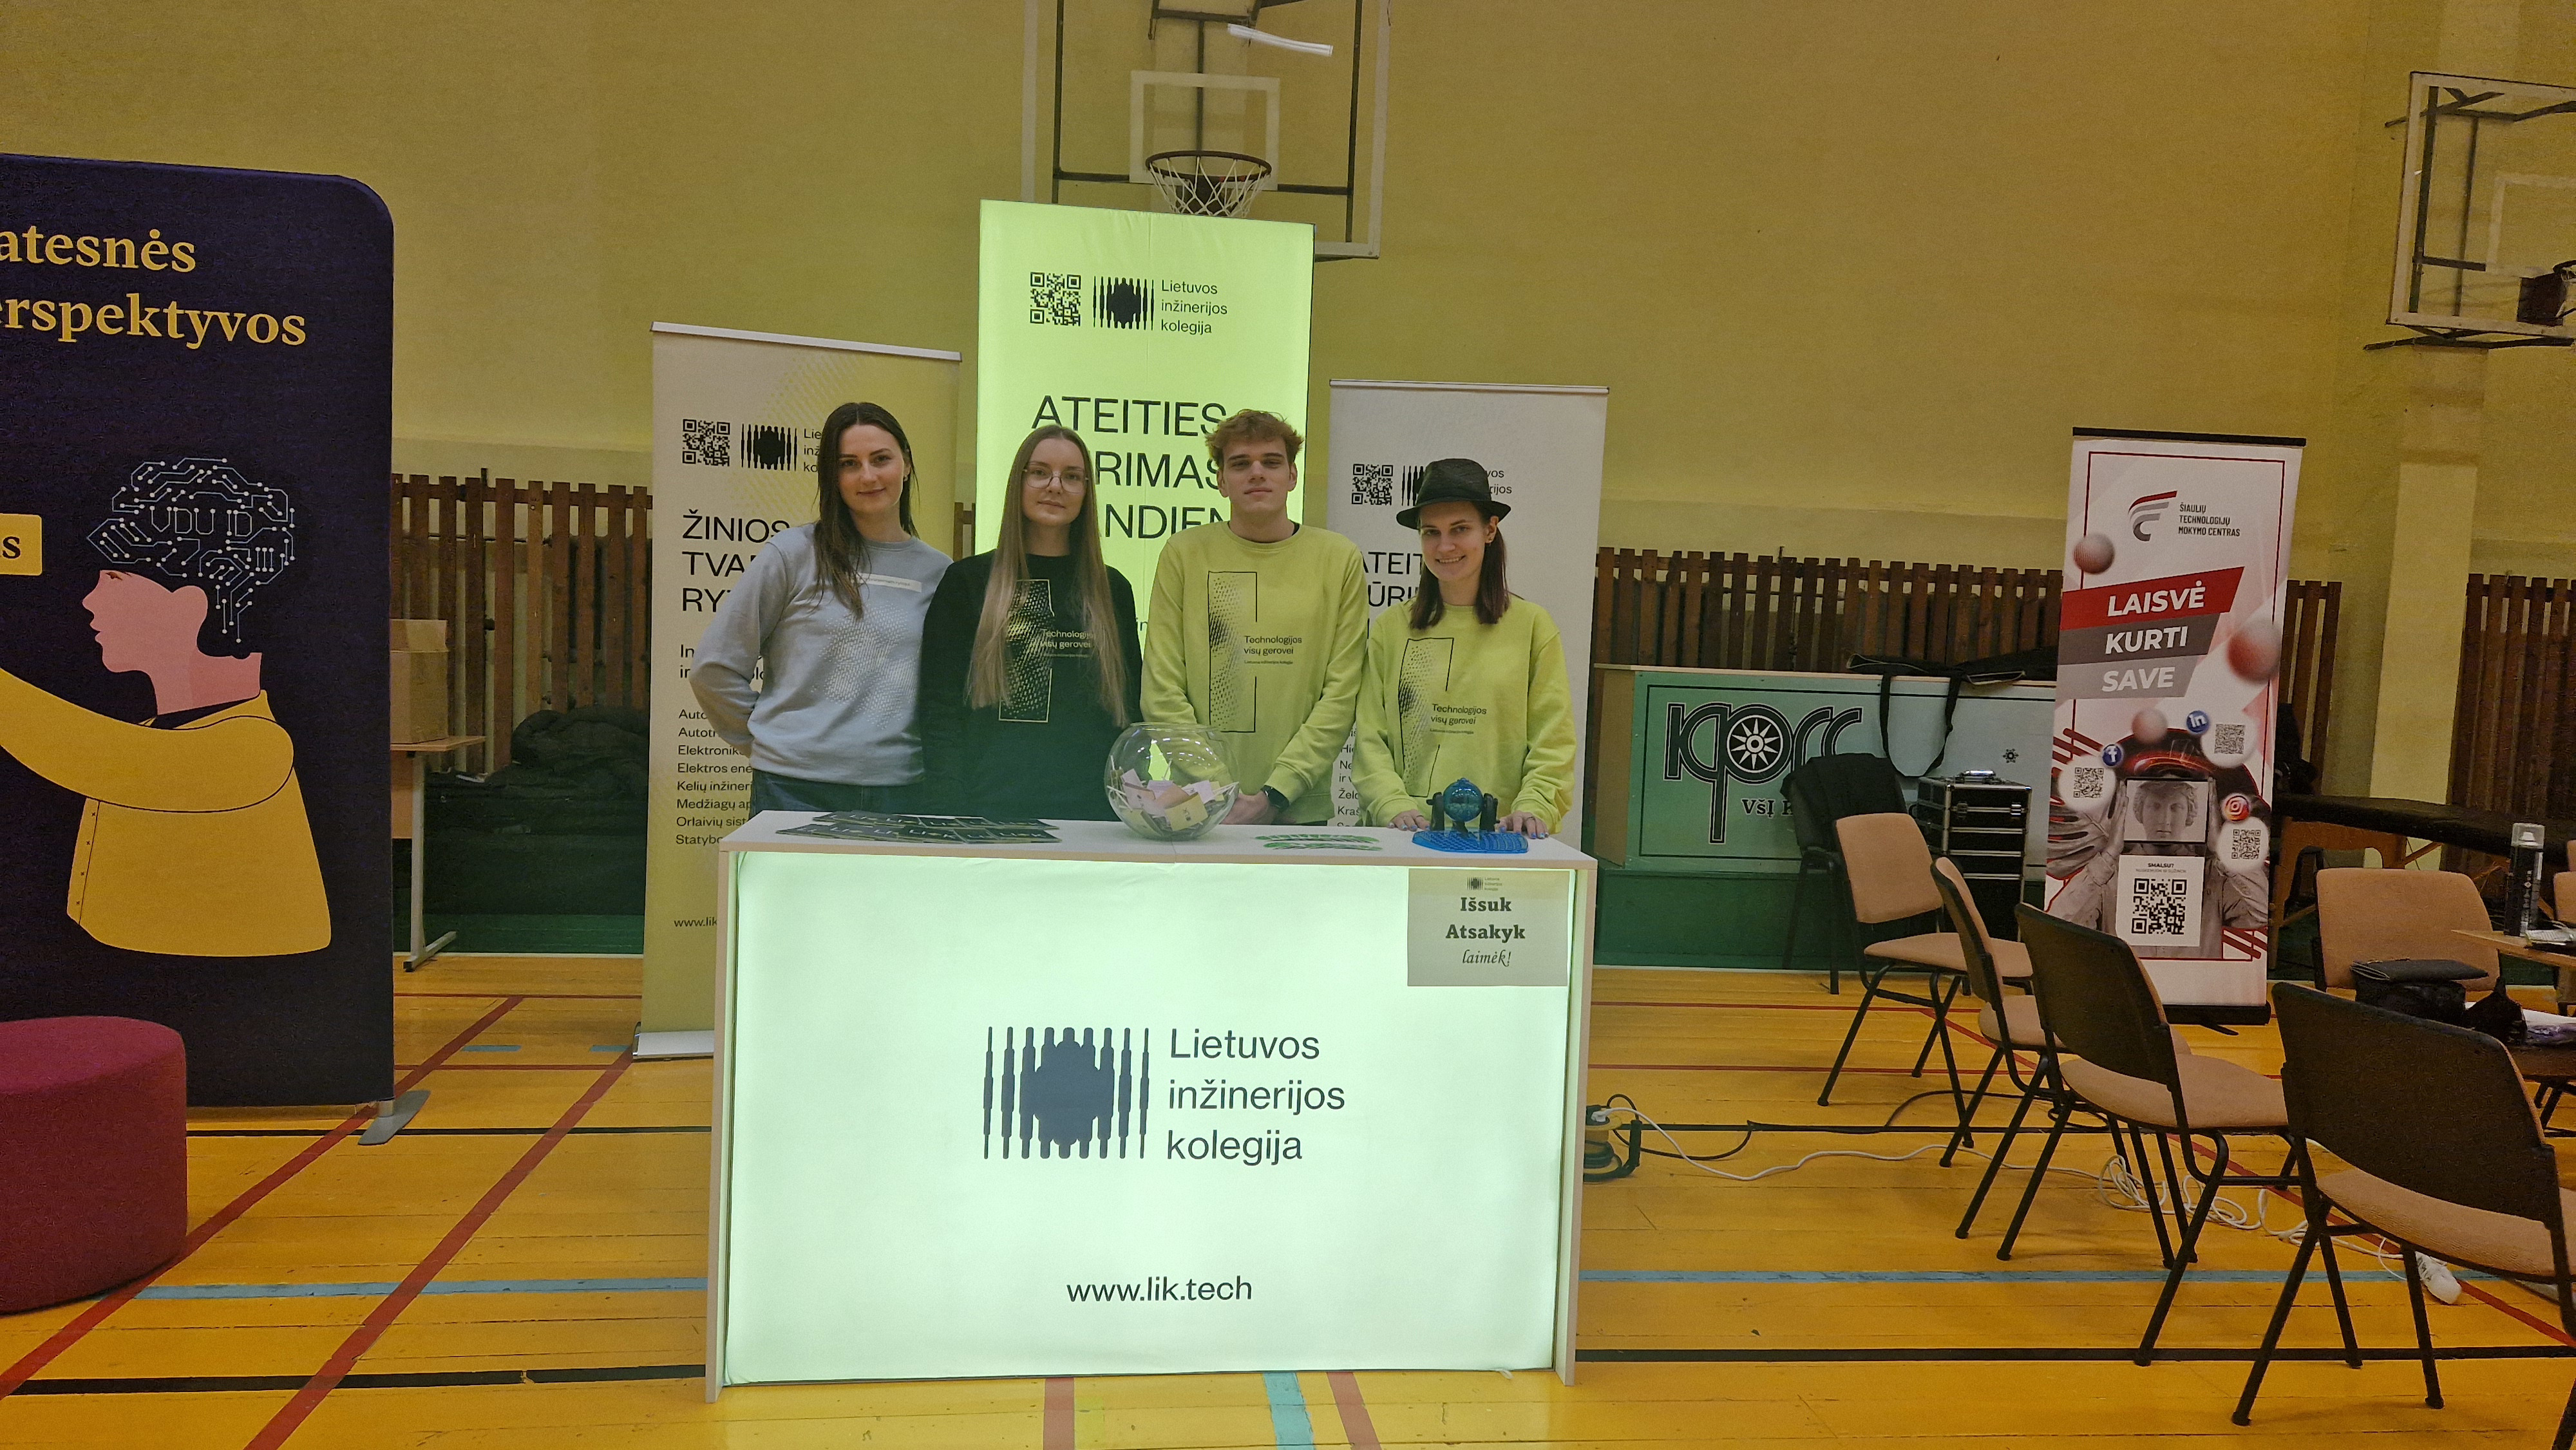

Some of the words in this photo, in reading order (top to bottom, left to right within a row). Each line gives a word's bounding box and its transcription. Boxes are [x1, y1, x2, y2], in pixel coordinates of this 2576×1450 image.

[0, 225, 196, 273] atesnės
[1161, 279, 1218, 295] Lietuvos
[1161, 299, 1228, 316] inžinerijos
[0, 293, 307, 350] rspektyvos
[1160, 318, 1212, 335] kolegija
[1031, 395, 1227, 437] ATEITIES
[804, 428, 822, 439] Lie
[804, 444, 820, 457] inž
[803, 461, 819, 473] ko
[1095, 451, 1220, 490] RIMAS
[1484, 470, 1504, 478] vos
[1489, 484, 1512, 495] rijos
[2179, 502, 2206, 514] ŠIAULIŲ
[2179, 514, 2231, 527] TECHNOLOGIJŲ
[2178, 526, 2206, 536] MOKYMO
[2208, 527, 2240, 537] CENTRAS
[682, 551, 757, 577] TVA
[683, 587, 731, 612] RY
[1367, 581, 1419, 607] ŪRI
[2107, 580, 2206, 617] LAISVĖ
[1040, 628, 1094, 640] Technologijo
[1244, 635, 1302, 645] Technologijos
[2105, 626, 2188, 655] KURTI
[1244, 646, 1261, 656] visų
[1262, 646, 1294, 656] gerovei
[2101, 666, 2175, 692] SAVE
[678, 709, 708, 720] Auto
[1432, 703, 1487, 715] Technologijos
[1430, 715, 1448, 725] visų
[1448, 717, 1477, 726] gerovei
[678, 745, 744, 756] Elektronik
[677, 762, 728, 773] Elektros
[730, 765, 753, 773] ene
[677, 781, 707, 793] Kelių
[710, 781, 752, 791] inžiner
[676, 798, 735, 811] Medžiagų
[676, 816, 723, 829] Orlaivių
[726, 816, 748, 826] sist
[676, 834, 723, 846] Statybo
[1460, 897, 1512, 912] Išsuk
[674, 916, 717, 927] www.lik
[1445, 924, 1526, 943] Atsakyk
[1462, 949, 1511, 967] laimėk!
[1170, 1028, 1320, 1060] Lietuvos
[1169, 1079, 1345, 1116] inžinerijos
[1167, 1129, 1303, 1167] kolegija
[1066, 1275, 1253, 1302] www.lik.tech
